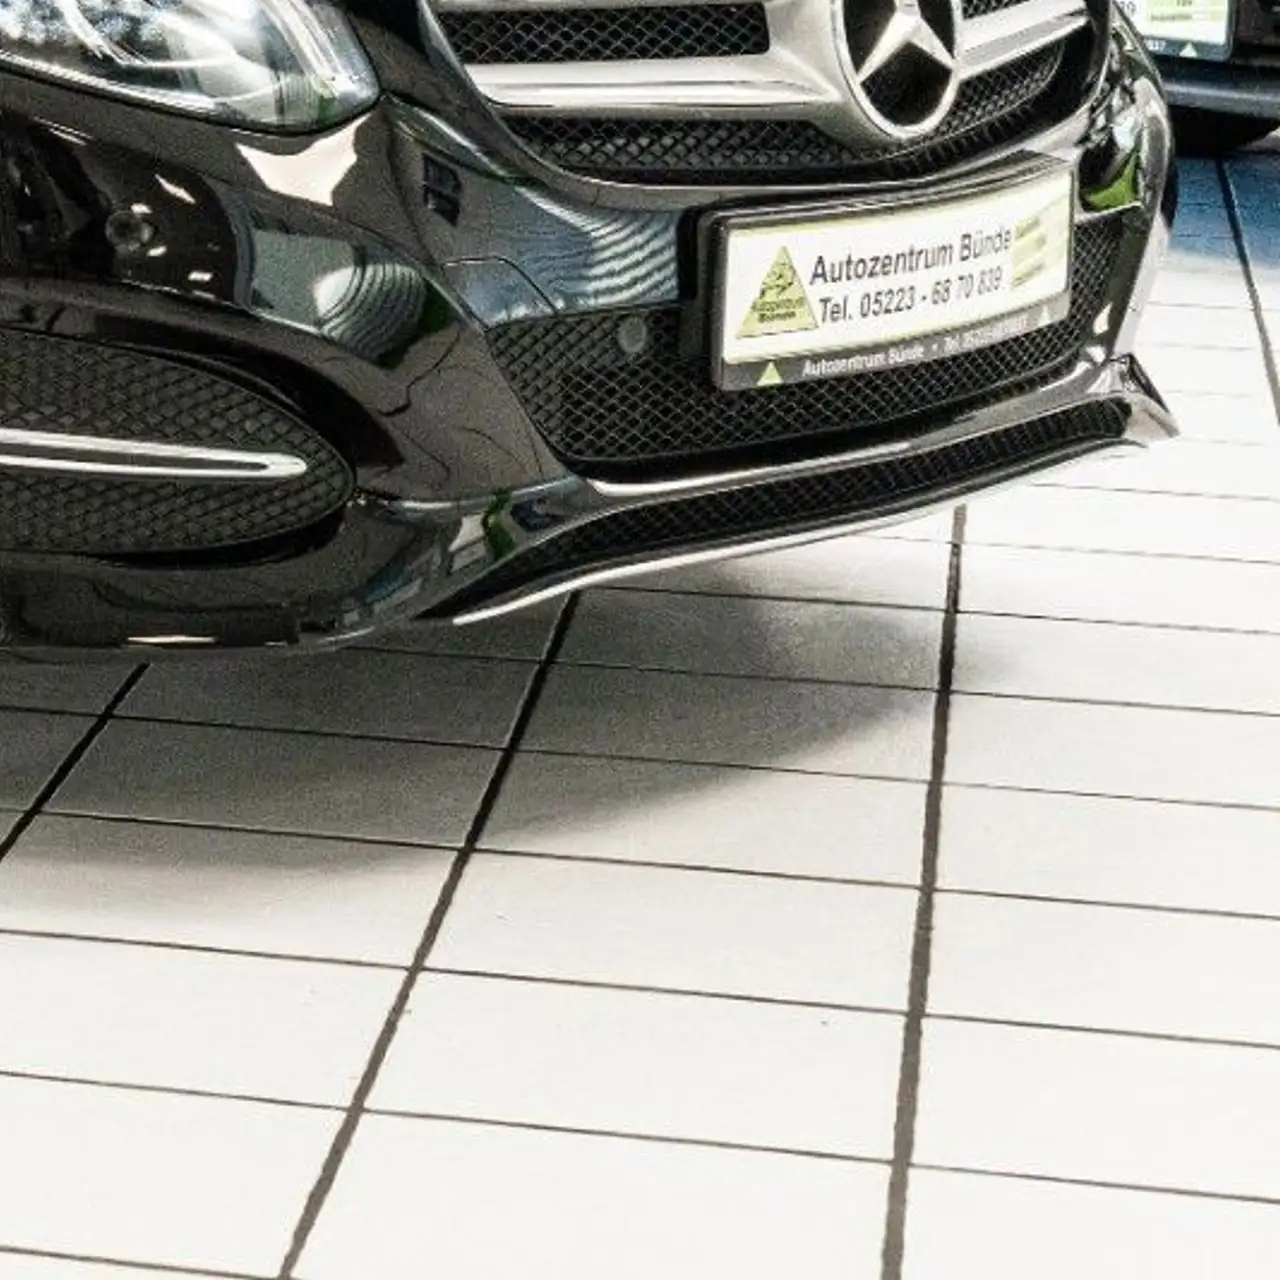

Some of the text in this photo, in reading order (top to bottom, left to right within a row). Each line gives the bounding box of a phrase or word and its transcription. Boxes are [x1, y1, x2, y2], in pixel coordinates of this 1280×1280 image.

[809, 242, 954, 286] Autozentrum
[958, 227, 1012, 263] Bünde
[819, 295, 854, 324] Tel.
[860, 286, 916, 319] 05223
